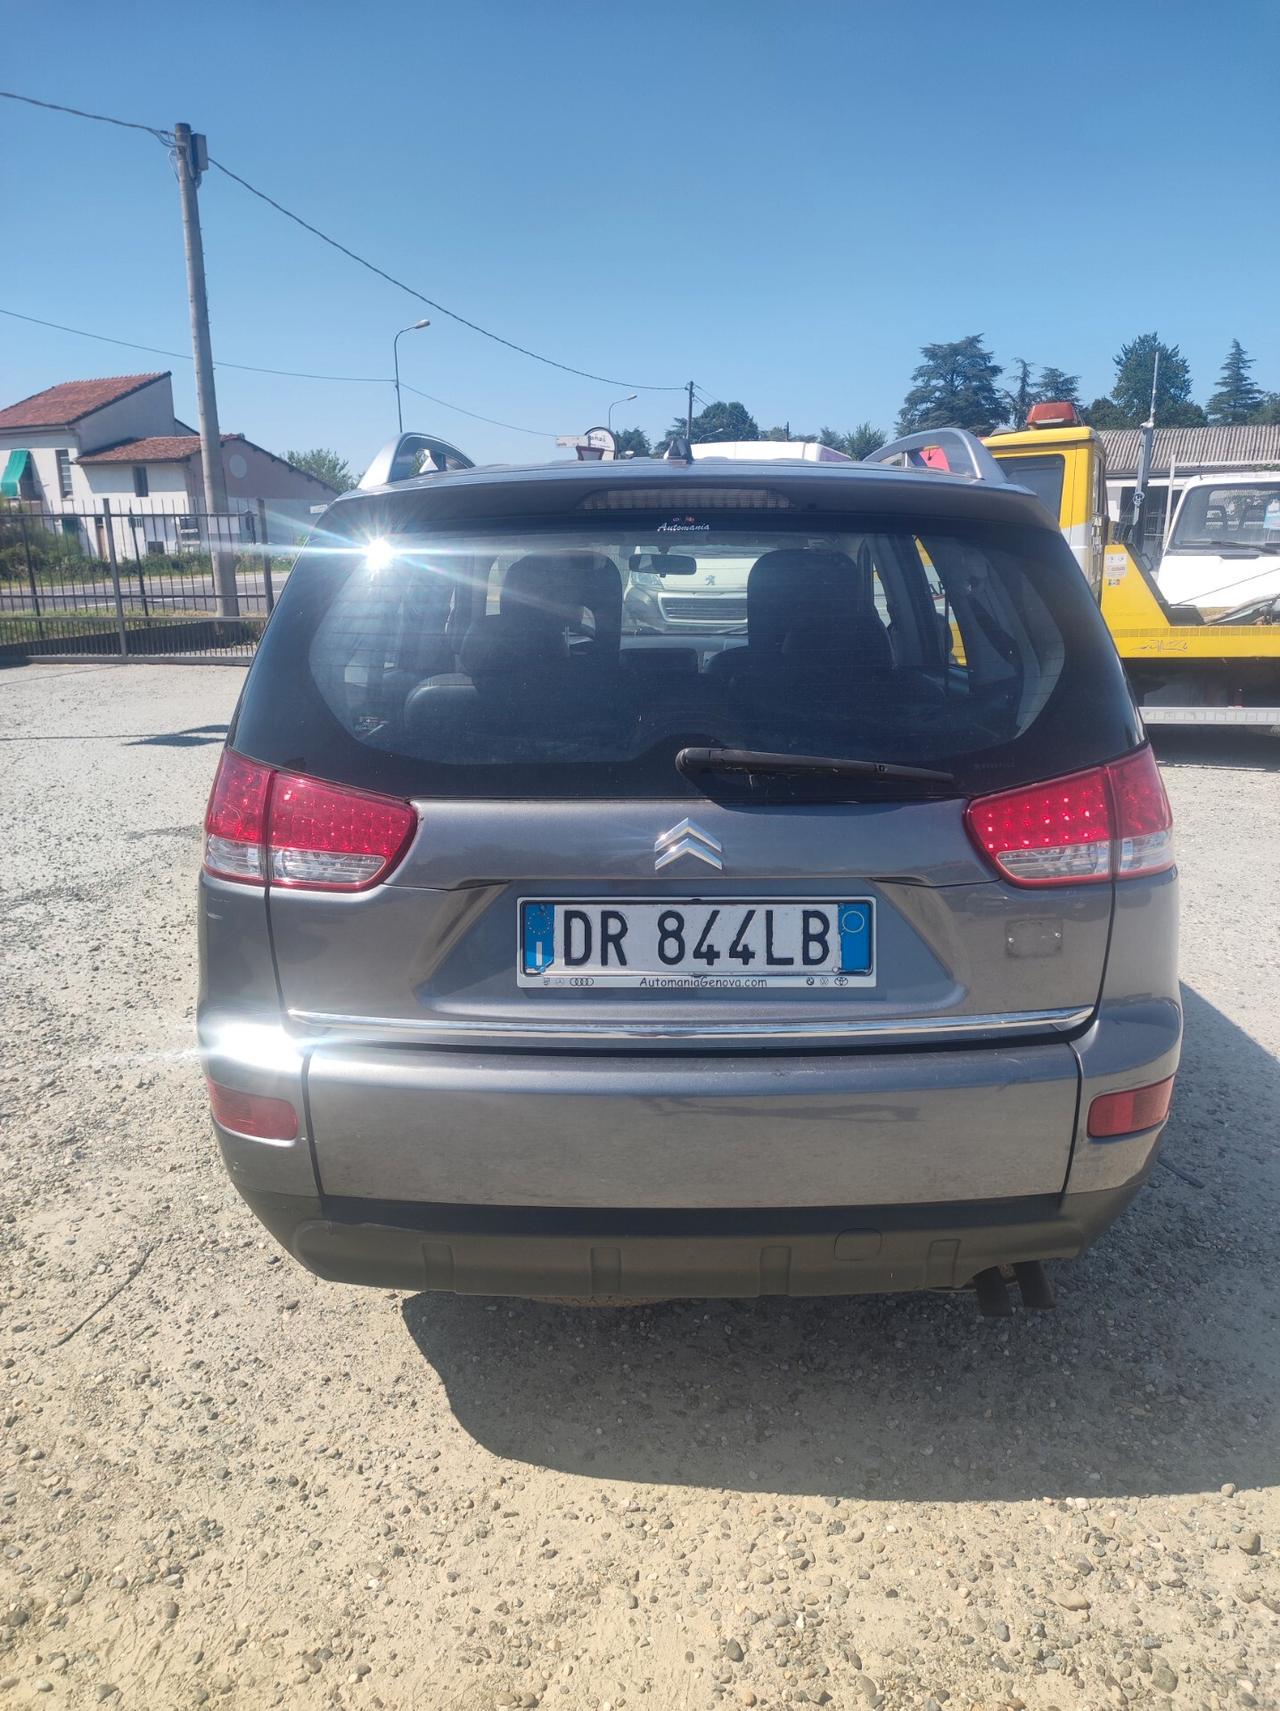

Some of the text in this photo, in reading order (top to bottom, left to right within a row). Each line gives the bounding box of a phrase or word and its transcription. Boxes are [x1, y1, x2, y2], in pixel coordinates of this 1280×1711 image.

[657, 522, 710, 531] Automania
[564, 910, 628, 966] DR
[640, 977, 768, 988] AutomaniaGenova.com
